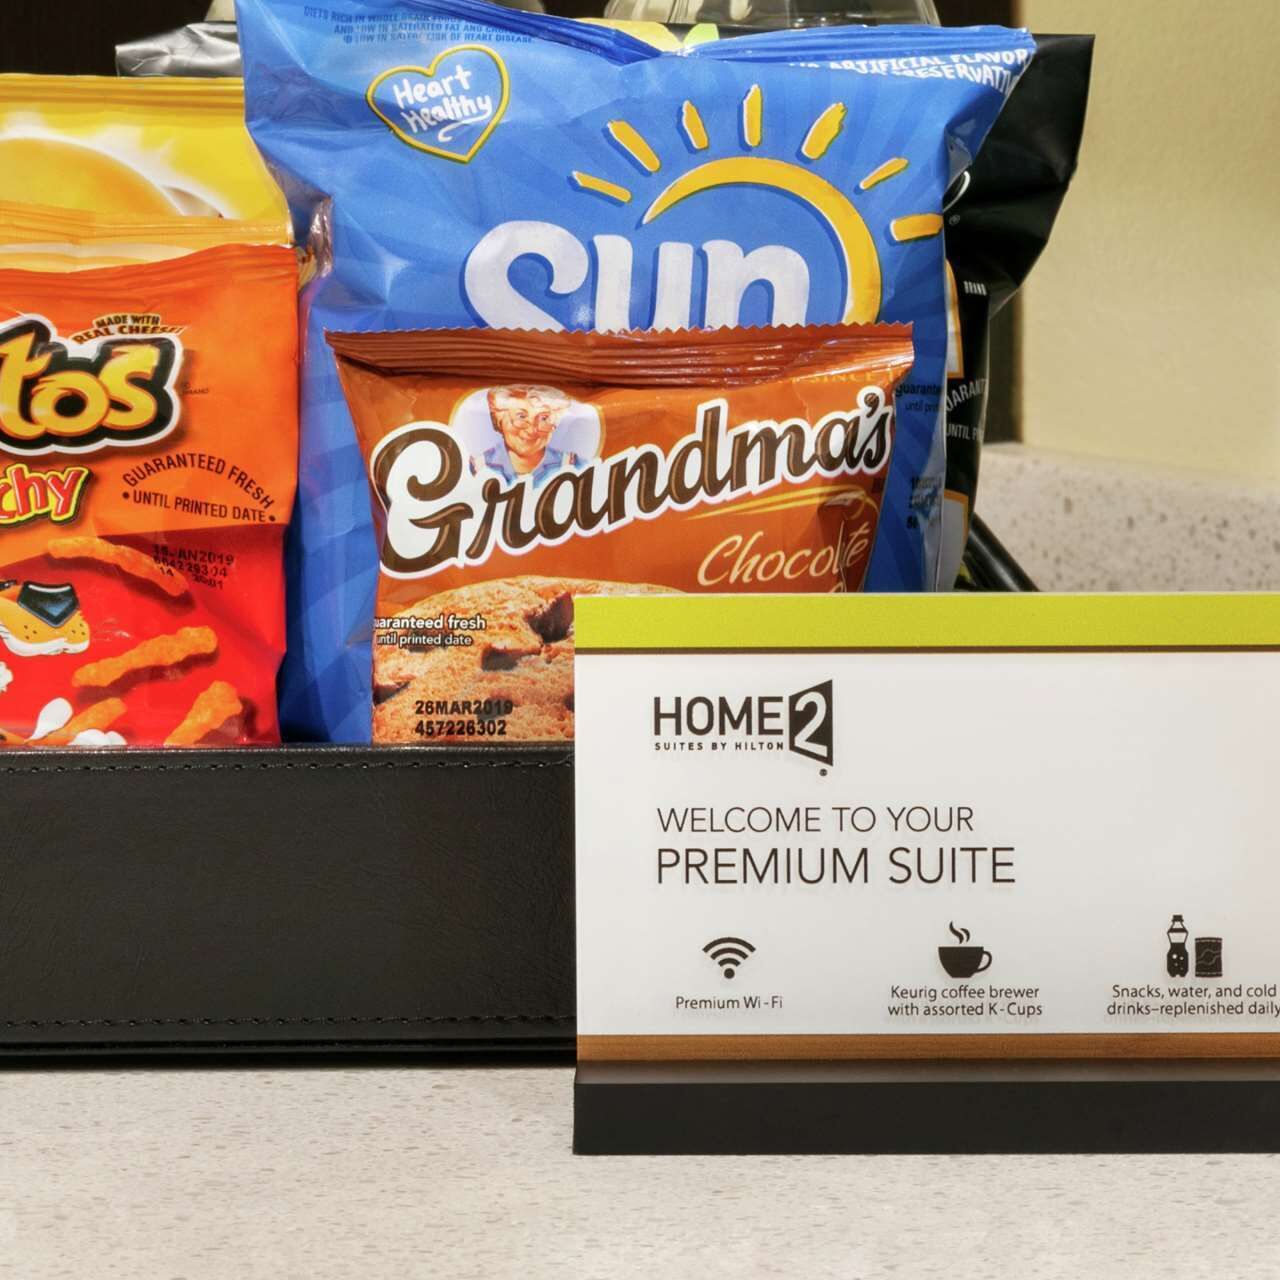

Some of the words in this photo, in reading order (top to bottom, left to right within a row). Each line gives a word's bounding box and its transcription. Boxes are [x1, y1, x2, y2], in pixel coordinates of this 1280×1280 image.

[950, 48, 1029, 65] FLAVOR
[393, 65, 471, 109] Heart
[401, 95, 493, 141] Healthy
[465, 220, 810, 333] Sun
[95, 315, 128, 328] MADE
[130, 314, 160, 326] WITH
[73, 325, 116, 345] REAL
[122, 453, 226, 487] GUARANTEED
[227, 466, 275, 509] FRESH
[372, 392, 892, 573] Grandma's
[133, 490, 170, 509] UNTIL
[174, 497, 228, 518] PRINTED
[232, 506, 266, 523] DATE
[697, 520, 869, 586] Chocolte
[374, 615, 443, 630] aranteed
[447, 615, 487, 630] fresh
[399, 634, 442, 649] printed
[444, 633, 473, 646] date
[415, 700, 513, 716] 26MAR2019
[655, 742, 704, 751] SUITES
[712, 742, 727, 751] BY
[735, 742, 784, 751] HILTON
[657, 806, 821, 832] WELCOME
[832, 806, 876, 832] TO
[887, 806, 974, 832] YOUR
[658, 847, 868, 884] PREMIUM
[888, 846, 1015, 884] SUITE
[891, 985, 937, 1002] Keurig
[941, 985, 985, 999] coffee
[989, 985, 1039, 1000] brewer
[1111, 984, 1165, 999] Snacks,
[1168, 986, 1212, 999] water,
[1215, 984, 1242, 998] and
[1246, 984, 1277, 998] cold
[675, 996, 741, 1009] Premium
[888, 1003, 919, 1016] with
[922, 1003, 984, 1016] assorted
